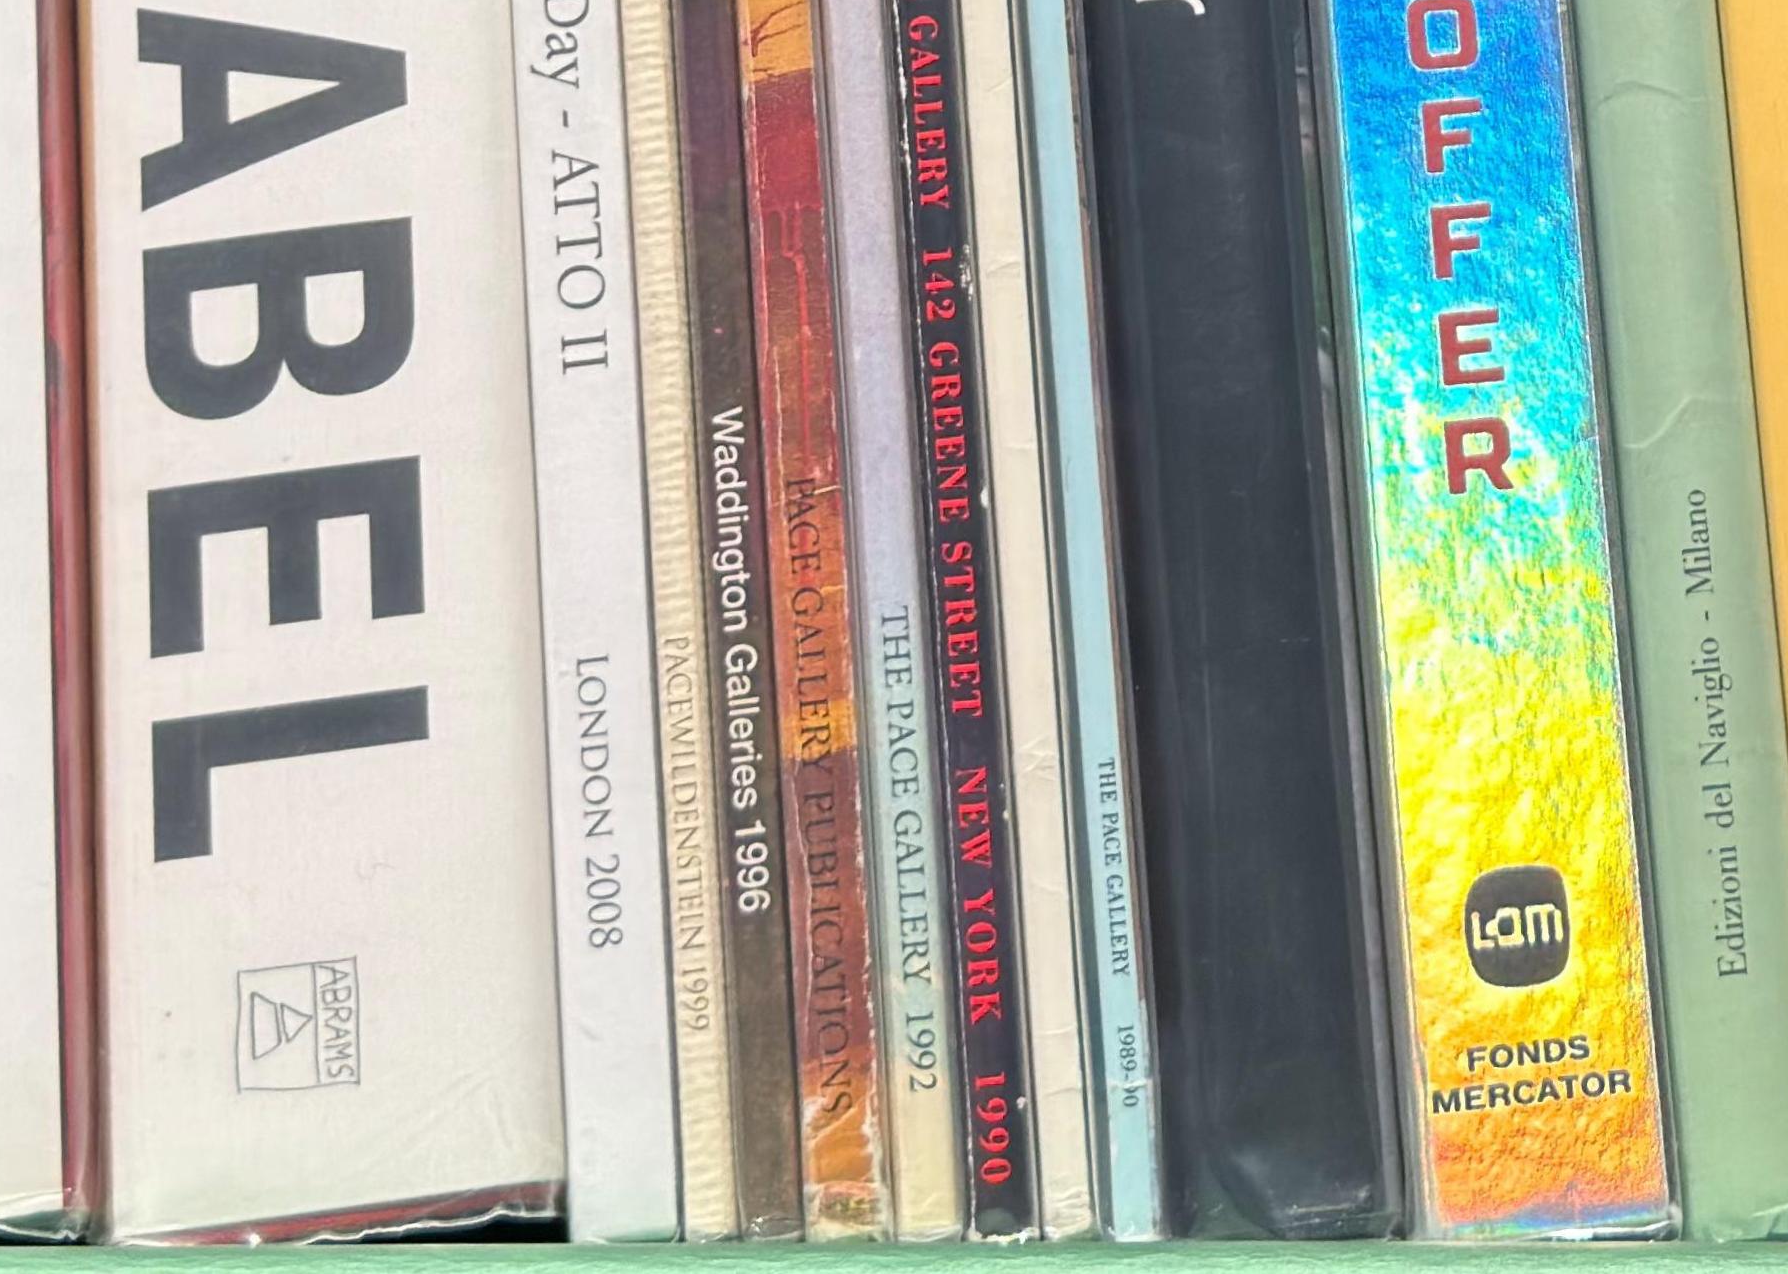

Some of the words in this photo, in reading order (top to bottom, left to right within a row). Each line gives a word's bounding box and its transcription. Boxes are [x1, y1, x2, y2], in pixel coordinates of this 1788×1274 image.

[908, 15, 950, 210] GALLERY
[551, 149, 607, 310] ATTO
[922, 247, 957, 323] 142
[561, 330, 609, 375] II
[928, 341, 972, 523] GREENE
[712, 407, 754, 633] Waddington
[784, 477, 820, 574] PACE
[1682, 489, 1715, 596] Milano
[793, 587, 835, 774] GALLERY
[880, 606, 913, 686] THE
[939, 542, 984, 719] STREET
[575, 655, 613, 839] LONDON
[725, 644, 766, 808] Galleries
[887, 700, 920, 798] PACE
[1692, 637, 1734, 769] Naviglio
[664, 637, 707, 951] PACEWILDENSTEIN
[955, 766, 994, 868] NEW
[1097, 758, 1118, 802] THE
[1702, 782, 1736, 829] del
[735, 820, 772, 913] 1996
[1101, 812, 1123, 865] PACE
[585, 855, 624, 949] 2008
[894, 810, 933, 985] GALLERY
[1106, 875, 1131, 977] GALLERY
[1713, 846, 1750, 978] Edizioni
[681, 965, 710, 1032] 1999
[802, 790, 853, 1113] PUBLICATIONS
[963, 889, 1003, 1026] YORK
[318, 964, 355, 1079] ABRAMS
[904, 1012, 937, 1093] 1992
[1466, 1034, 1591, 1072] FONDS
[974, 1072, 1013, 1186] 1990
[1432, 1068, 1632, 1114] MERCATOR
